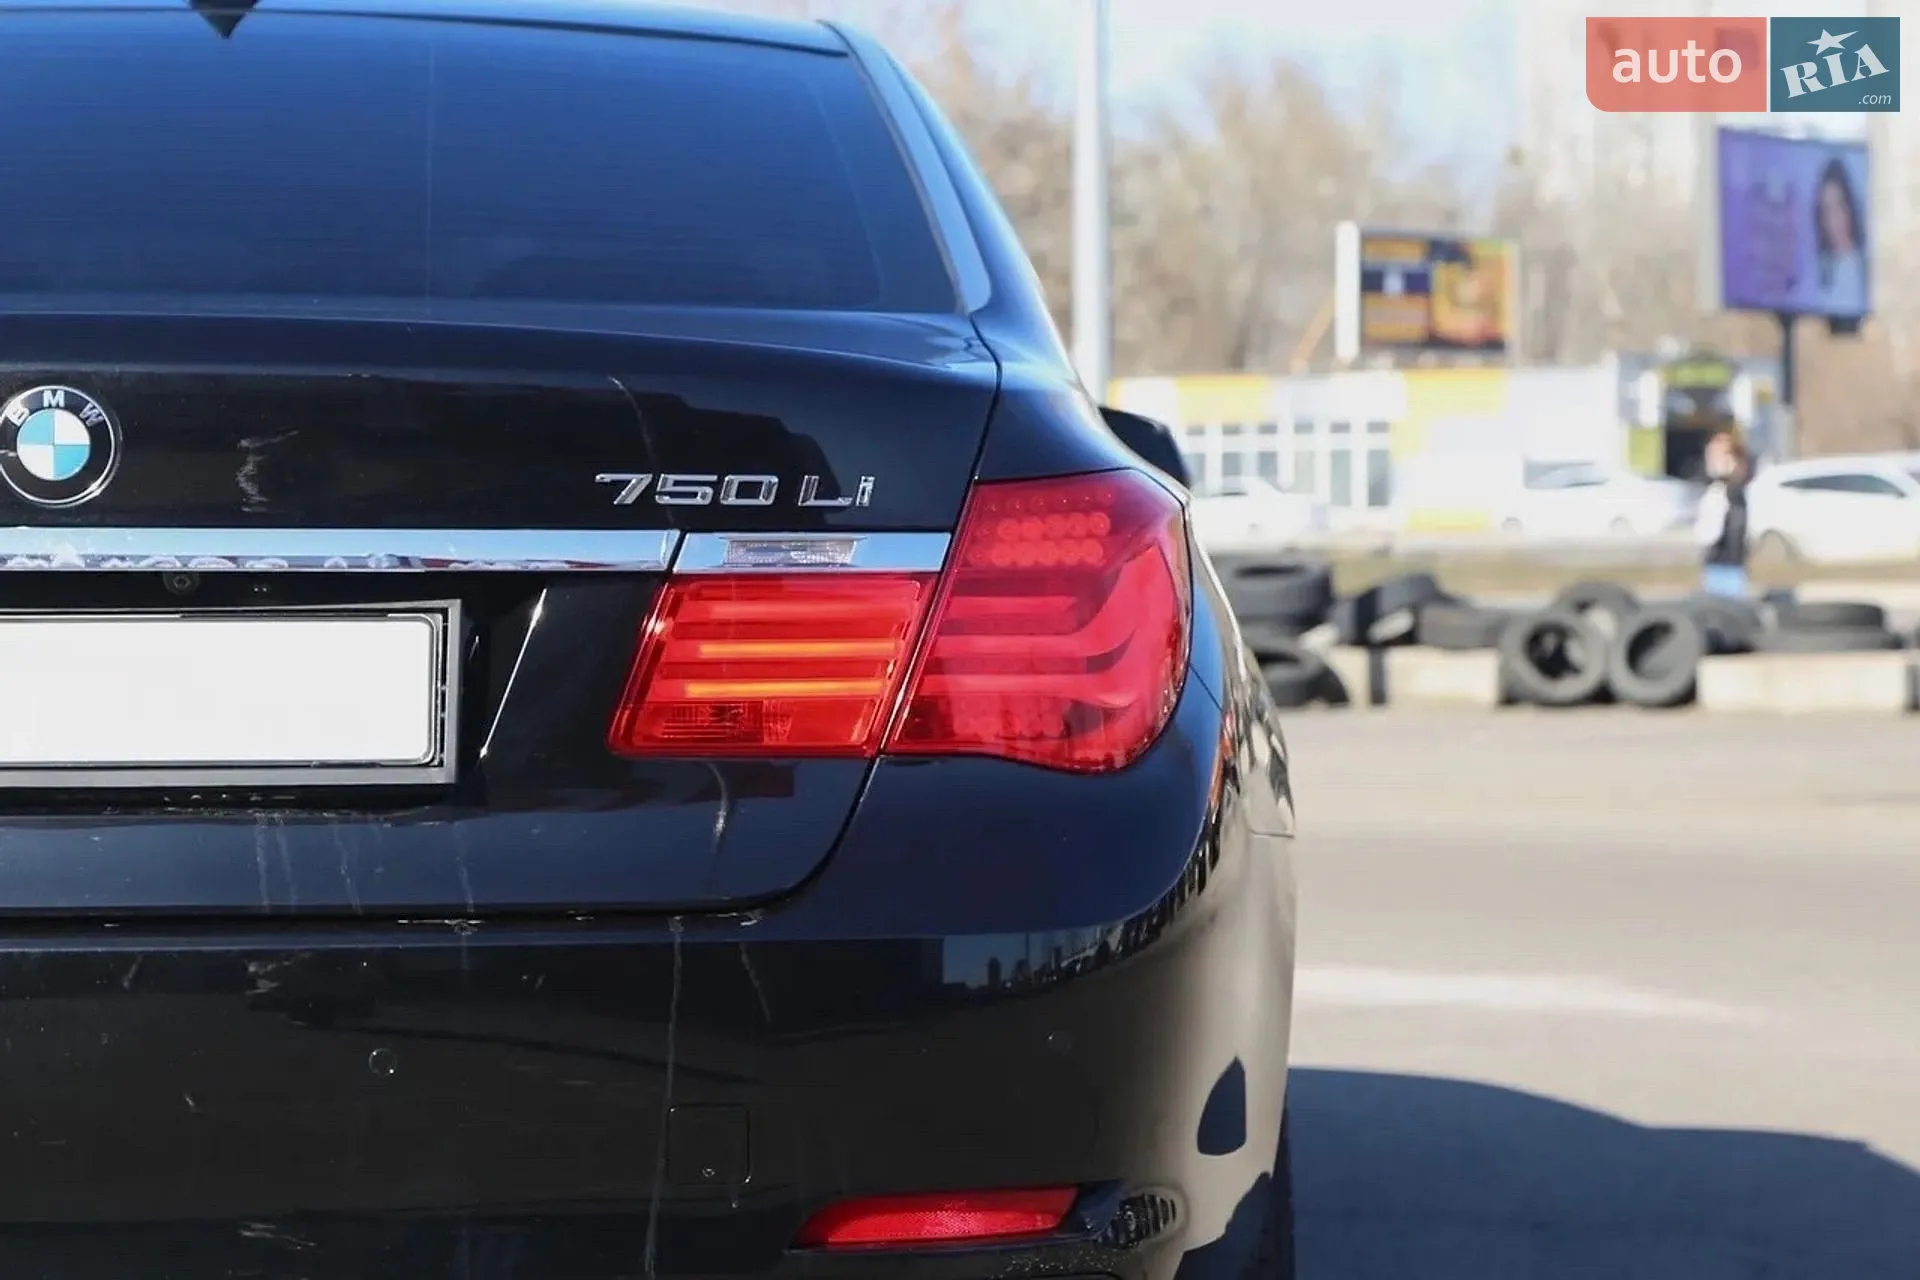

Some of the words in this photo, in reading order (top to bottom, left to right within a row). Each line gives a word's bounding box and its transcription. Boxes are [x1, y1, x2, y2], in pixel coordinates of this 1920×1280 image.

[5, 389, 104, 427] BMW
[595, 473, 779, 505] 750
[798, 475, 876, 507] Li
